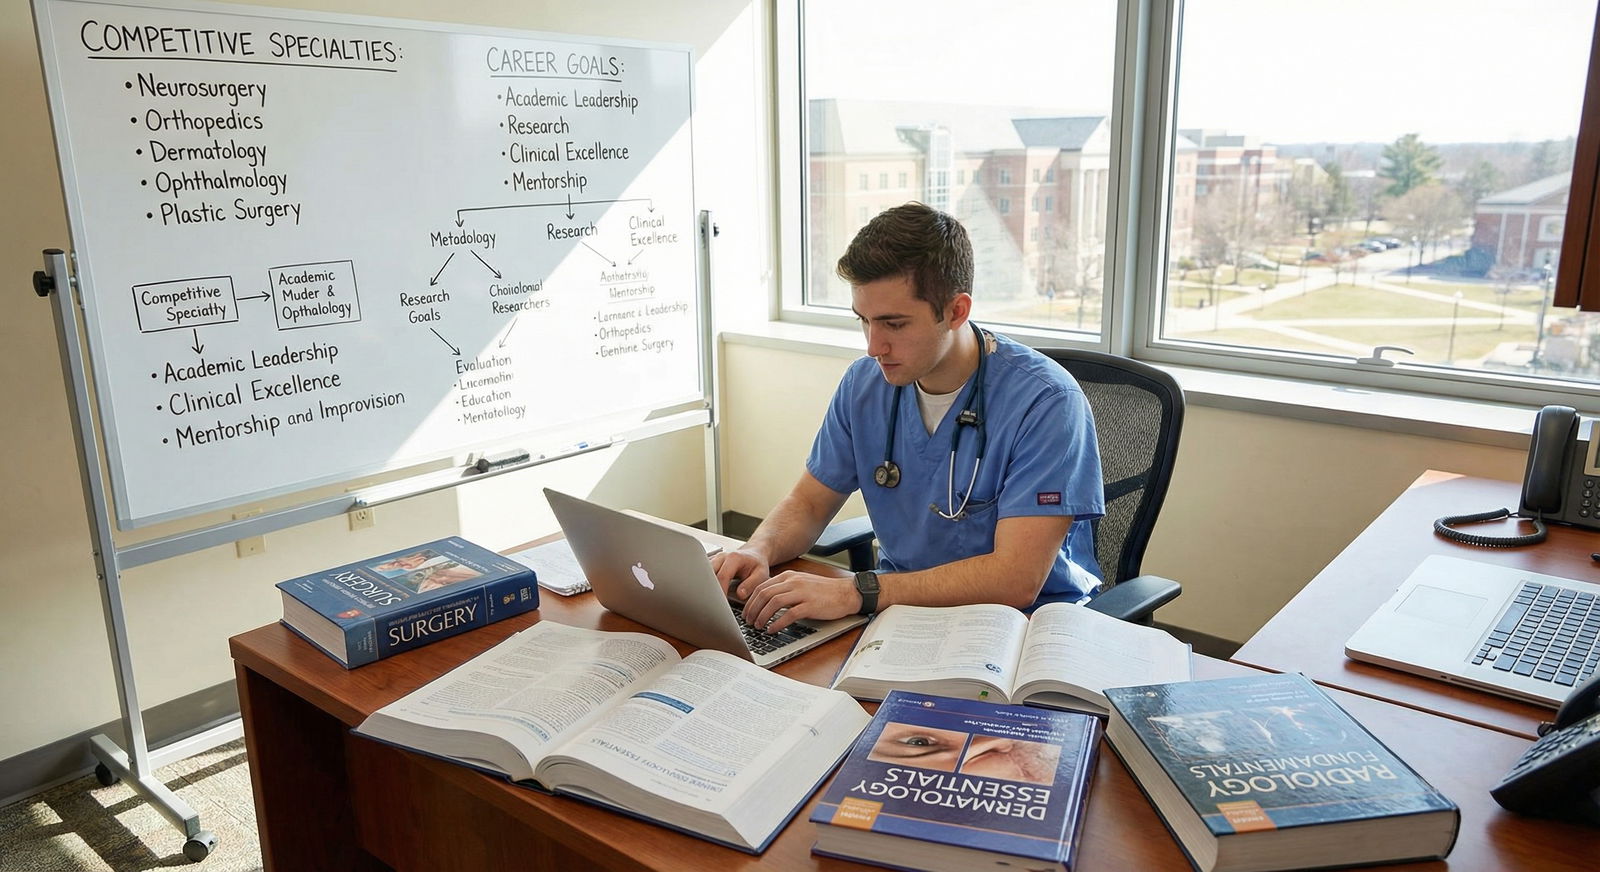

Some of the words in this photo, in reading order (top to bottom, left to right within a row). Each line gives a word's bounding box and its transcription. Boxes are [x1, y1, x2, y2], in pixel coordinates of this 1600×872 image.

[81, 20, 254, 55] COMPETITIVE
[269, 32, 403, 63] SPECIALTIES:
[486, 46, 558, 74] CAREER
[566, 53, 625, 76] GOALS:
[137, 73, 267, 107] Neurosurgery
[505, 86, 568, 107] Academic
[575, 89, 639, 115] Leadership
[145, 108, 263, 137] Orthopedics
[508, 114, 569, 135] Research
[150, 139, 267, 167] Dermatology
[510, 142, 560, 164] Clinical
[566, 141, 629, 162] Excellence
[155, 168, 287, 198] Ophthalmology
[513, 170, 587, 193] Mentorship
[160, 202, 226, 226] Plastic
[234, 198, 301, 226] Surgery
[629, 215, 665, 230] Clinical
[547, 221, 598, 240] Research
[630, 231, 679, 247] Excellence
[278, 270, 336, 286] Academic
[141, 286, 222, 307] Competitive
[282, 287, 320, 302] Muder
[327, 284, 336, 297] &
[400, 289, 450, 307] Research
[282, 301, 352, 323] Opthalology
[408, 308, 441, 324] Goals
[492, 298, 551, 314] Researchers
[600, 322, 651, 340] Orthopedics
[642, 338, 674, 354] Surgery
[164, 356, 246, 384] Academic
[251, 342, 339, 370] Leadership
[456, 355, 512, 375] Evaluation
[169, 383, 242, 416] Clinical
[251, 371, 342, 401] Excellence
[461, 390, 512, 407] Education
[175, 414, 280, 449] Mentorship
[287, 408, 313, 427] and
[319, 391, 406, 423] Improvision
[328, 569, 402, 606] SURGERY
[388, 603, 478, 647] SURGERY
[1189, 750, 1380, 779] FUNDAMENTALS
[884, 767, 1051, 805] ESSENTIALS
[1208, 762, 1399, 798] RADIOLOGY
[851, 778, 1048, 822] DERMATOLOGY
